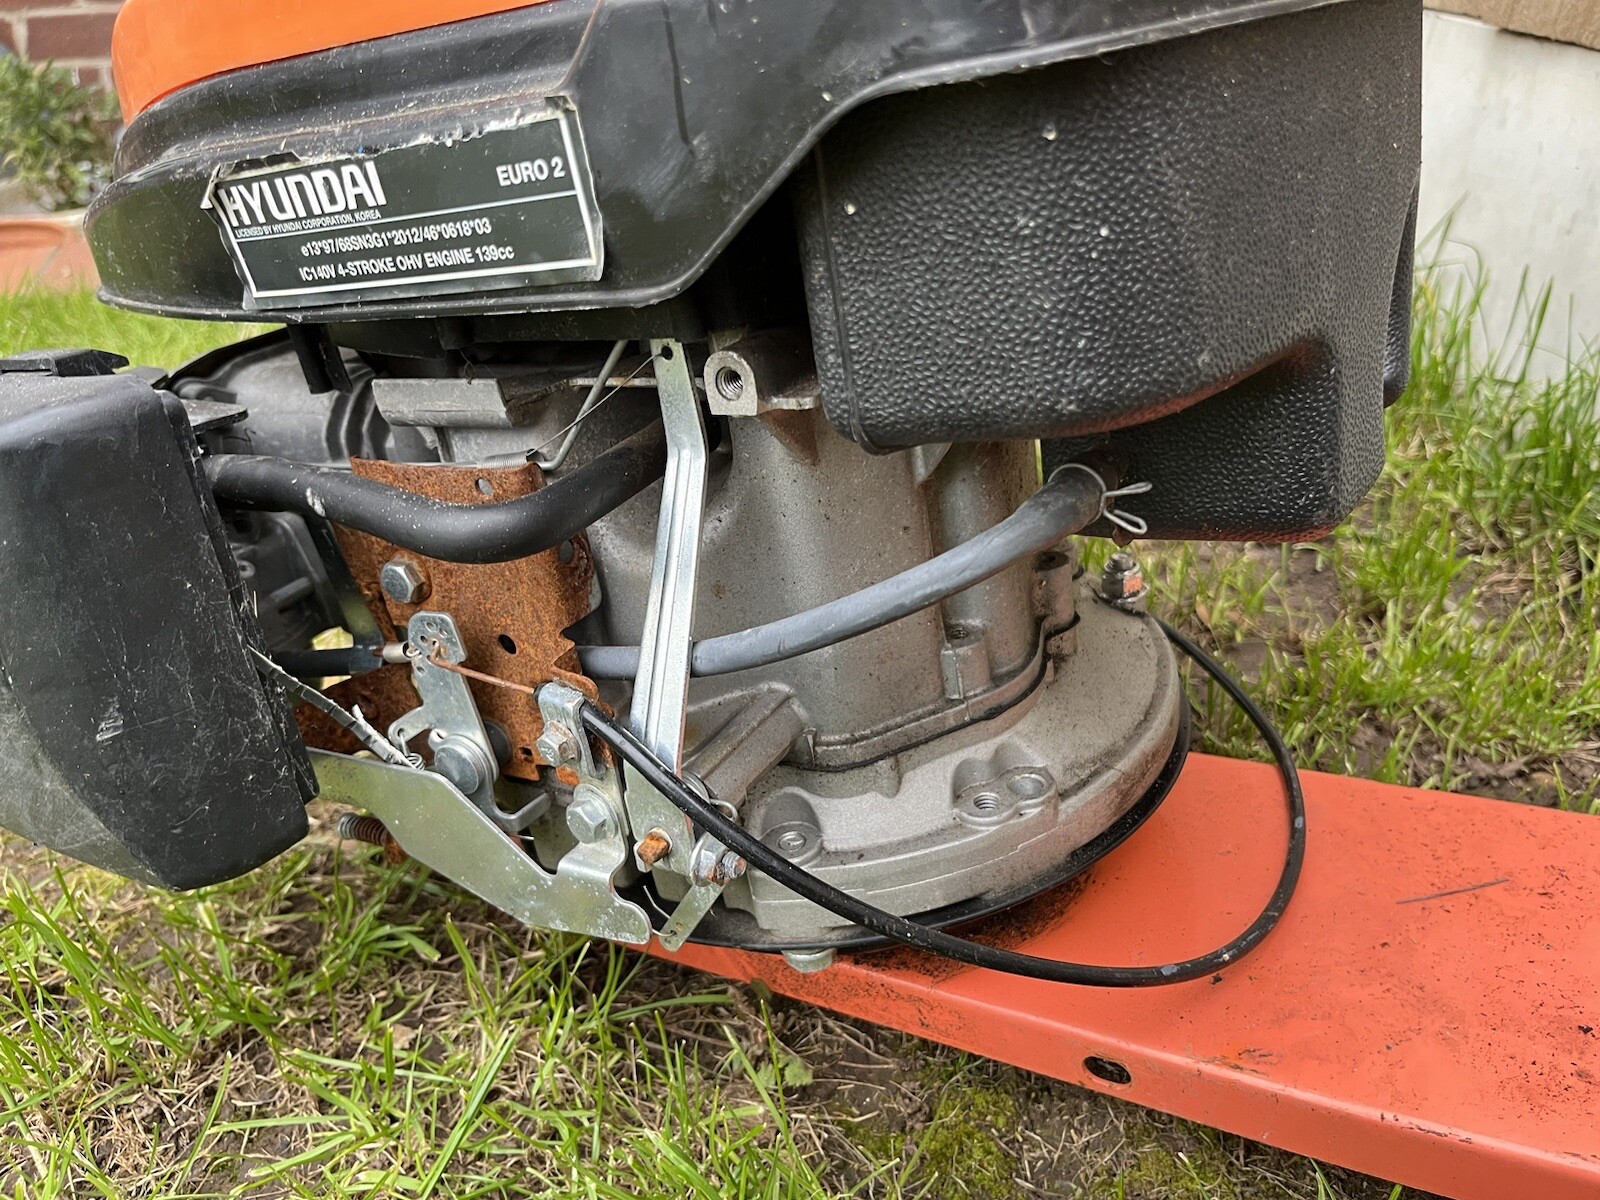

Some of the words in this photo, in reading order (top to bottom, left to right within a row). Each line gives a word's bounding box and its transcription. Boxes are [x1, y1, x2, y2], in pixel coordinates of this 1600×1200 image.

[496, 159, 549, 188] EURO
[551, 156, 566, 179] 2
[219, 160, 387, 227] HYUNDAI
[235, 229, 264, 238] LICENSED
[264, 227, 273, 235] BY
[273, 222, 302, 234] HYUNDAI
[302, 213, 355, 229] CORPORATION,
[355, 209, 382, 221] KOREA
[299, 263, 337, 282] IC140V
[337, 257, 395, 277] 4-STROKE
[395, 254, 424, 271] OHV
[424, 247, 475, 268] ENGINE
[475, 244, 515, 263] 139cc
